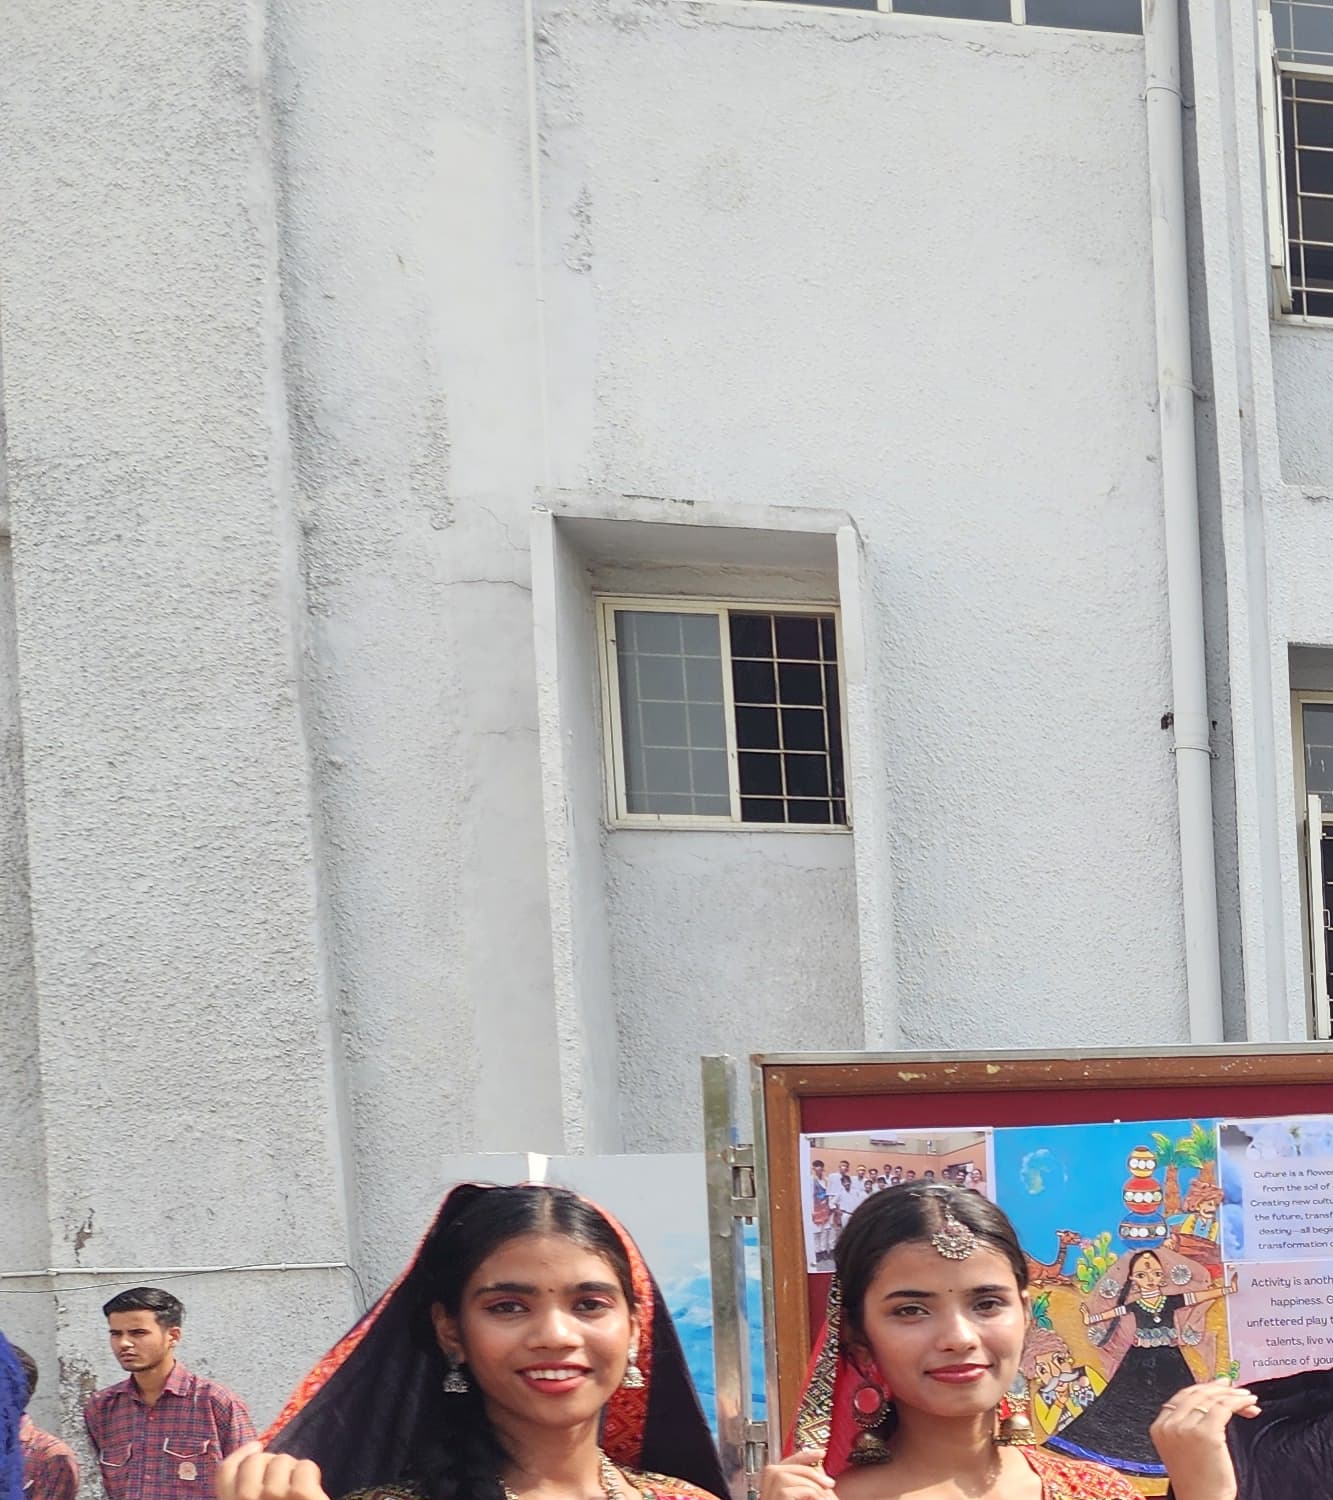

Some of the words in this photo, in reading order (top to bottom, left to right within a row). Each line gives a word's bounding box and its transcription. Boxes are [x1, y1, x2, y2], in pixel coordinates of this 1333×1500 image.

[1272, 1213, 1303, 1221] future,
[1259, 1241, 1327, 1249] transformation
[1251, 1278, 1291, 1288] Activity
[1294, 1277, 1302, 1286] is
[1247, 1317, 1303, 1327] unfettered
[1306, 1317, 1327, 1326] play
[1266, 1337, 1304, 1347] talents,
[1307, 1336, 1323, 1345] live
[1253, 1357, 1296, 1367] radiance
[1300, 1356, 1310, 1365] of
